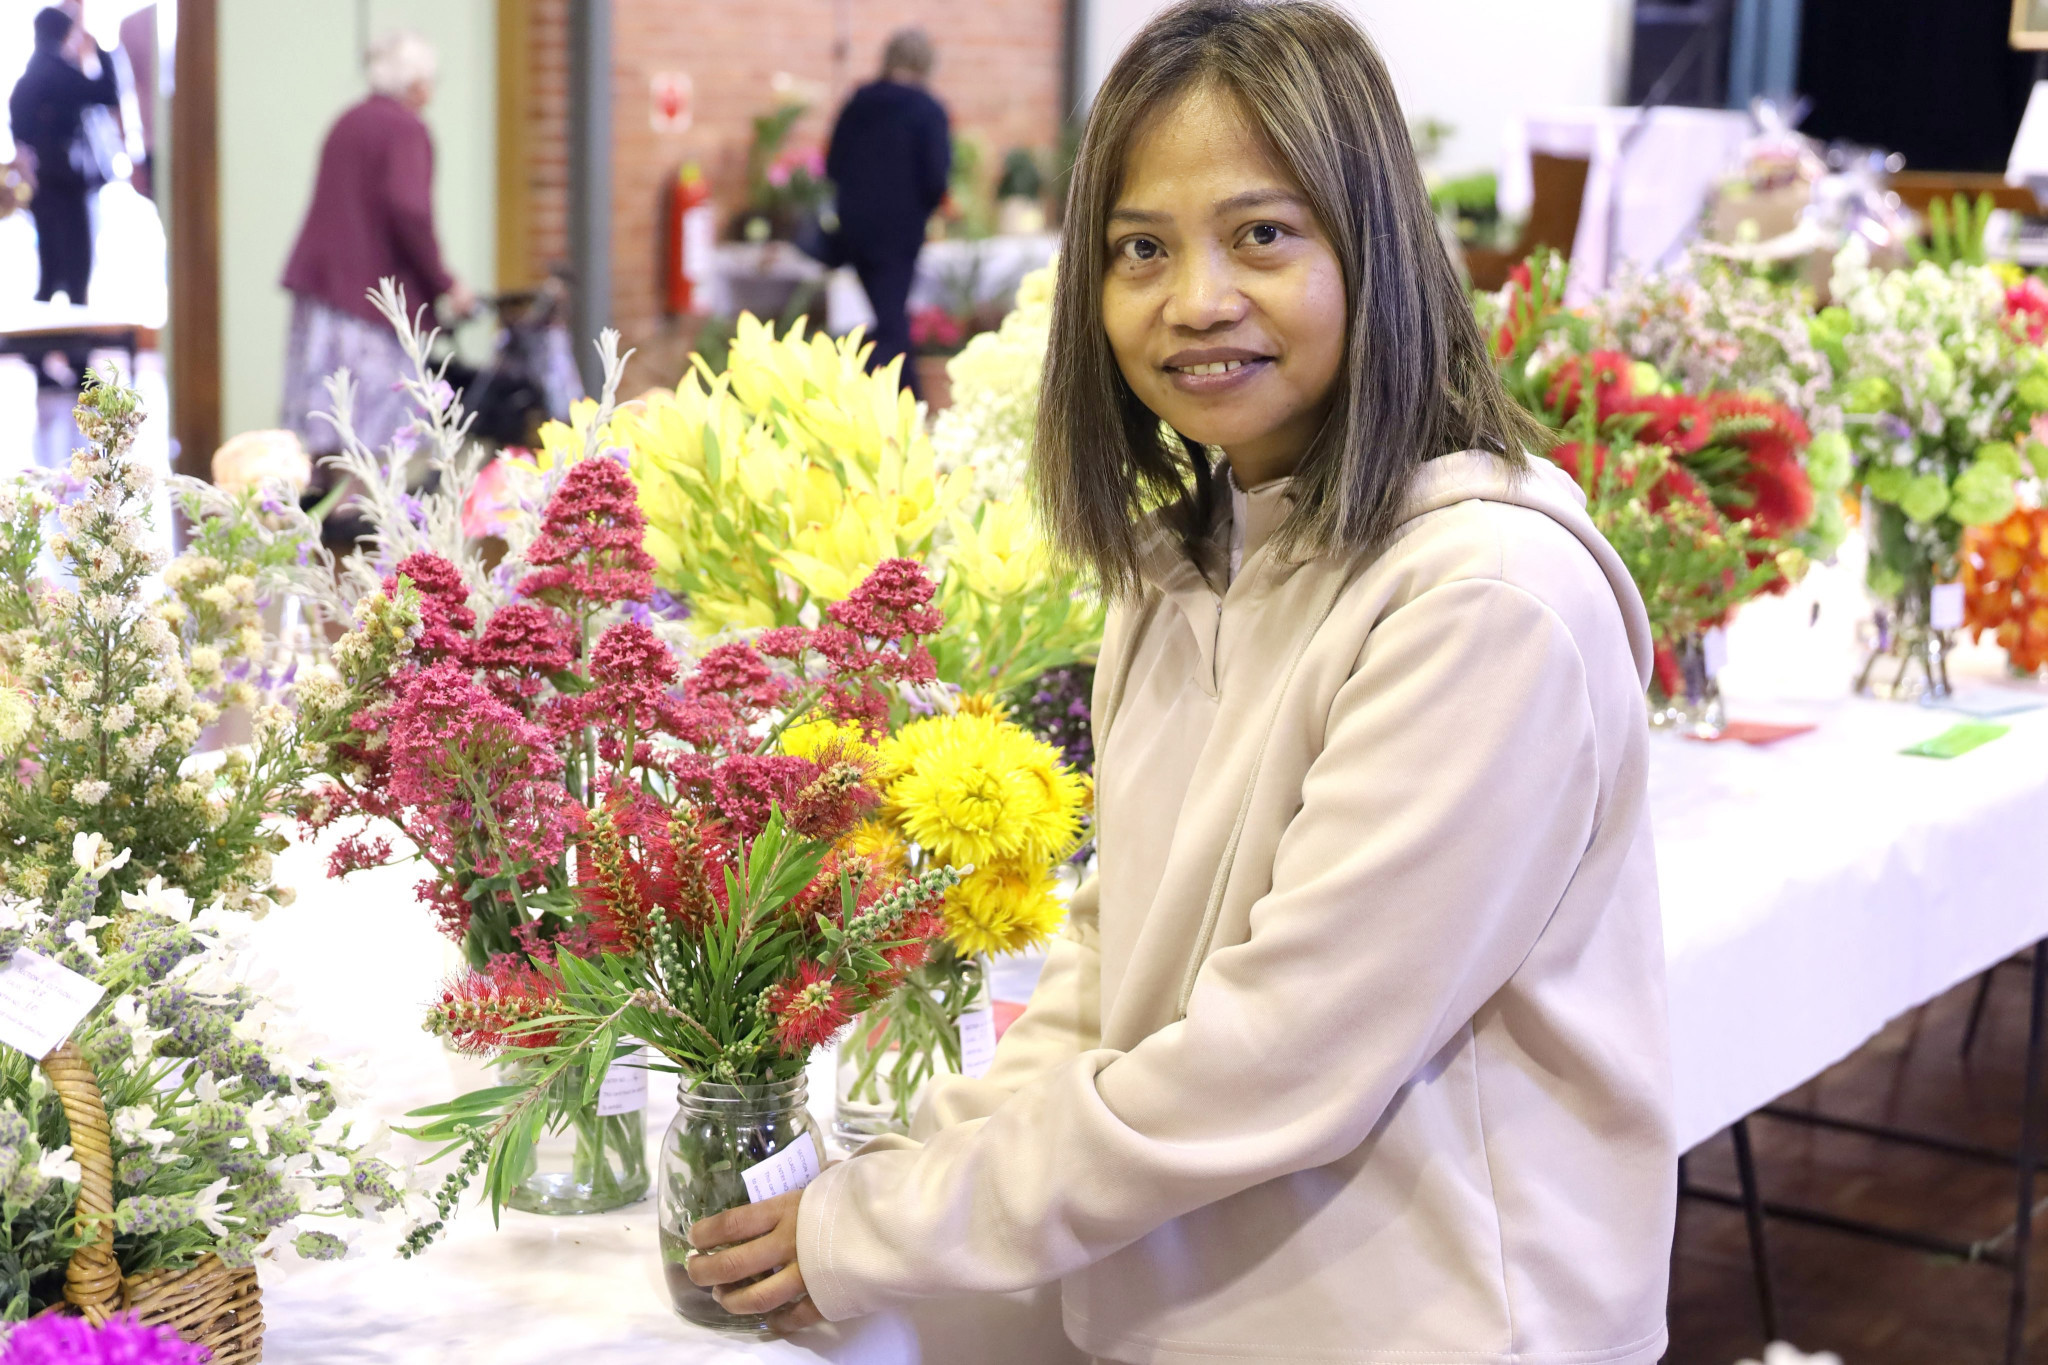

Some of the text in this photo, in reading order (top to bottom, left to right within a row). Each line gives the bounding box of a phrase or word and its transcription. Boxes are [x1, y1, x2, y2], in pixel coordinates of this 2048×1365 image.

[787, 1156, 796, 1174] CLASS
[797, 1149, 809, 1173] SECTION
[776, 1164, 786, 1181] ENTRY
[769, 1184, 777, 1195] card
